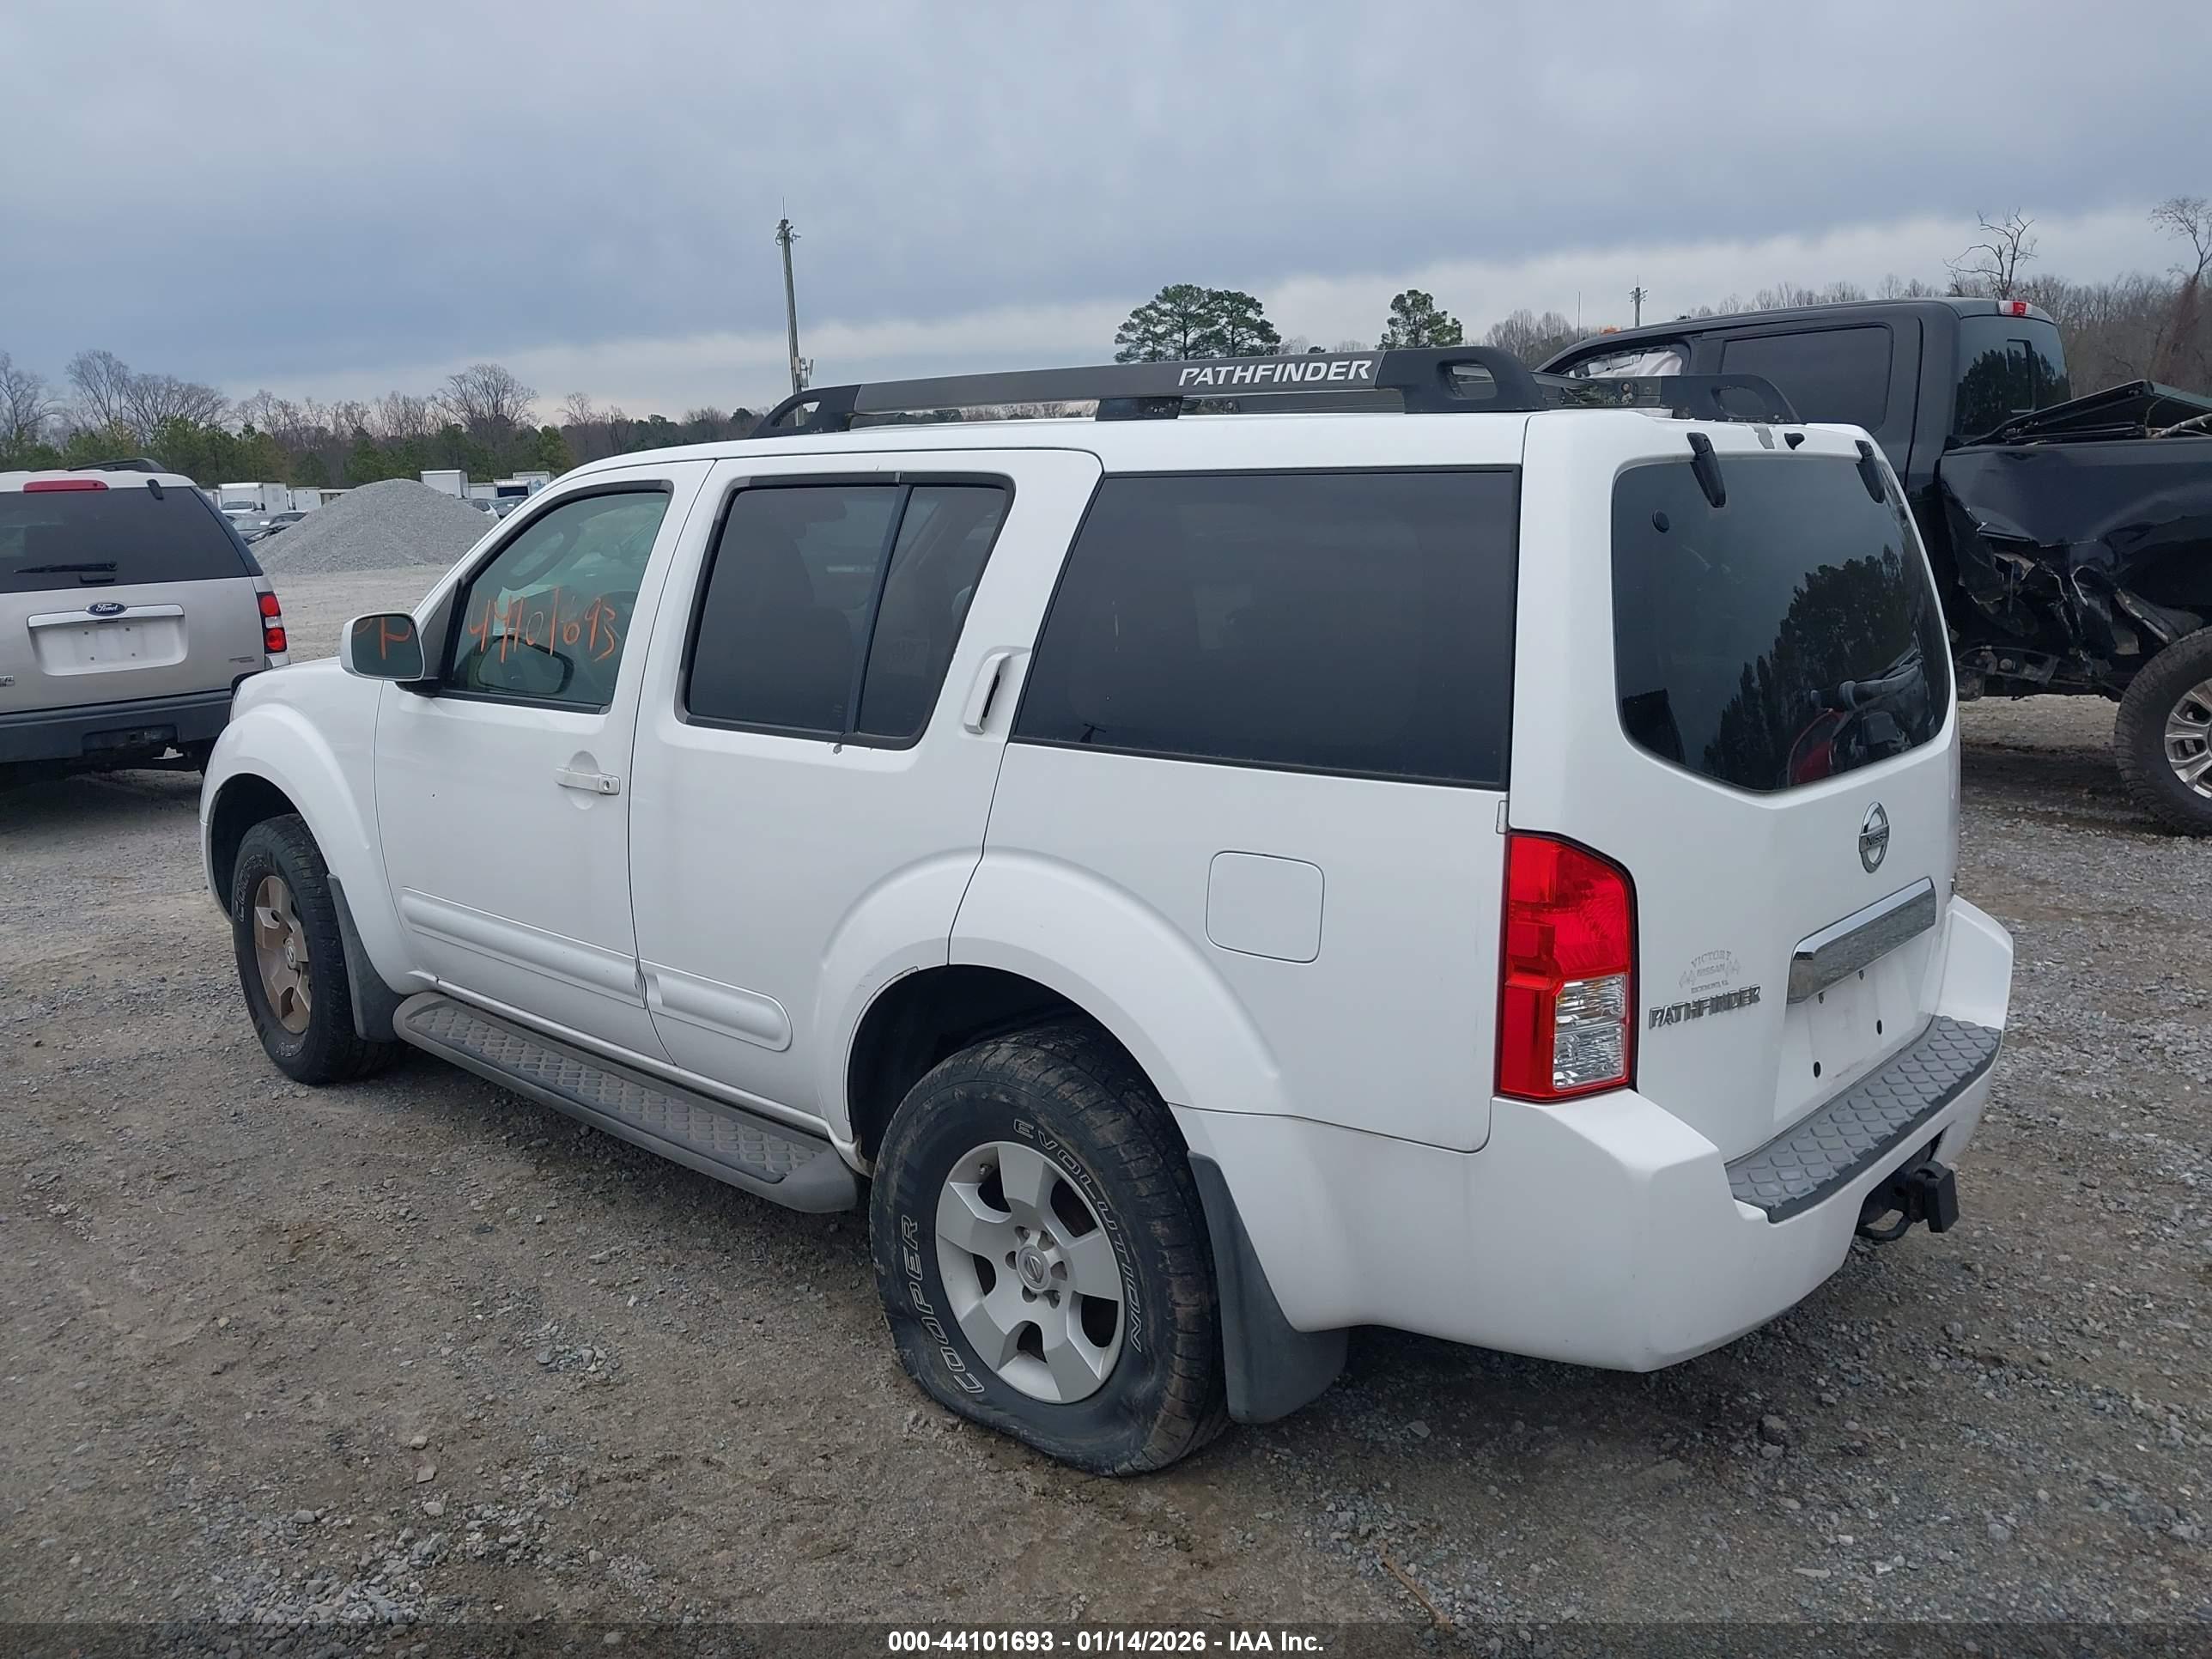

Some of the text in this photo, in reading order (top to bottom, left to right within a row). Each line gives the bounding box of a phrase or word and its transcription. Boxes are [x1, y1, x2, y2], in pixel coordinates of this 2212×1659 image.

[1178, 359, 1373, 387] PATHFINDER
[95, 603, 118, 612] Ford
[1648, 983, 1761, 1030] PATHFINDER
[1012, 1118, 1145, 1354] EVOLUTION
[900, 1214, 985, 1395] COOPER
